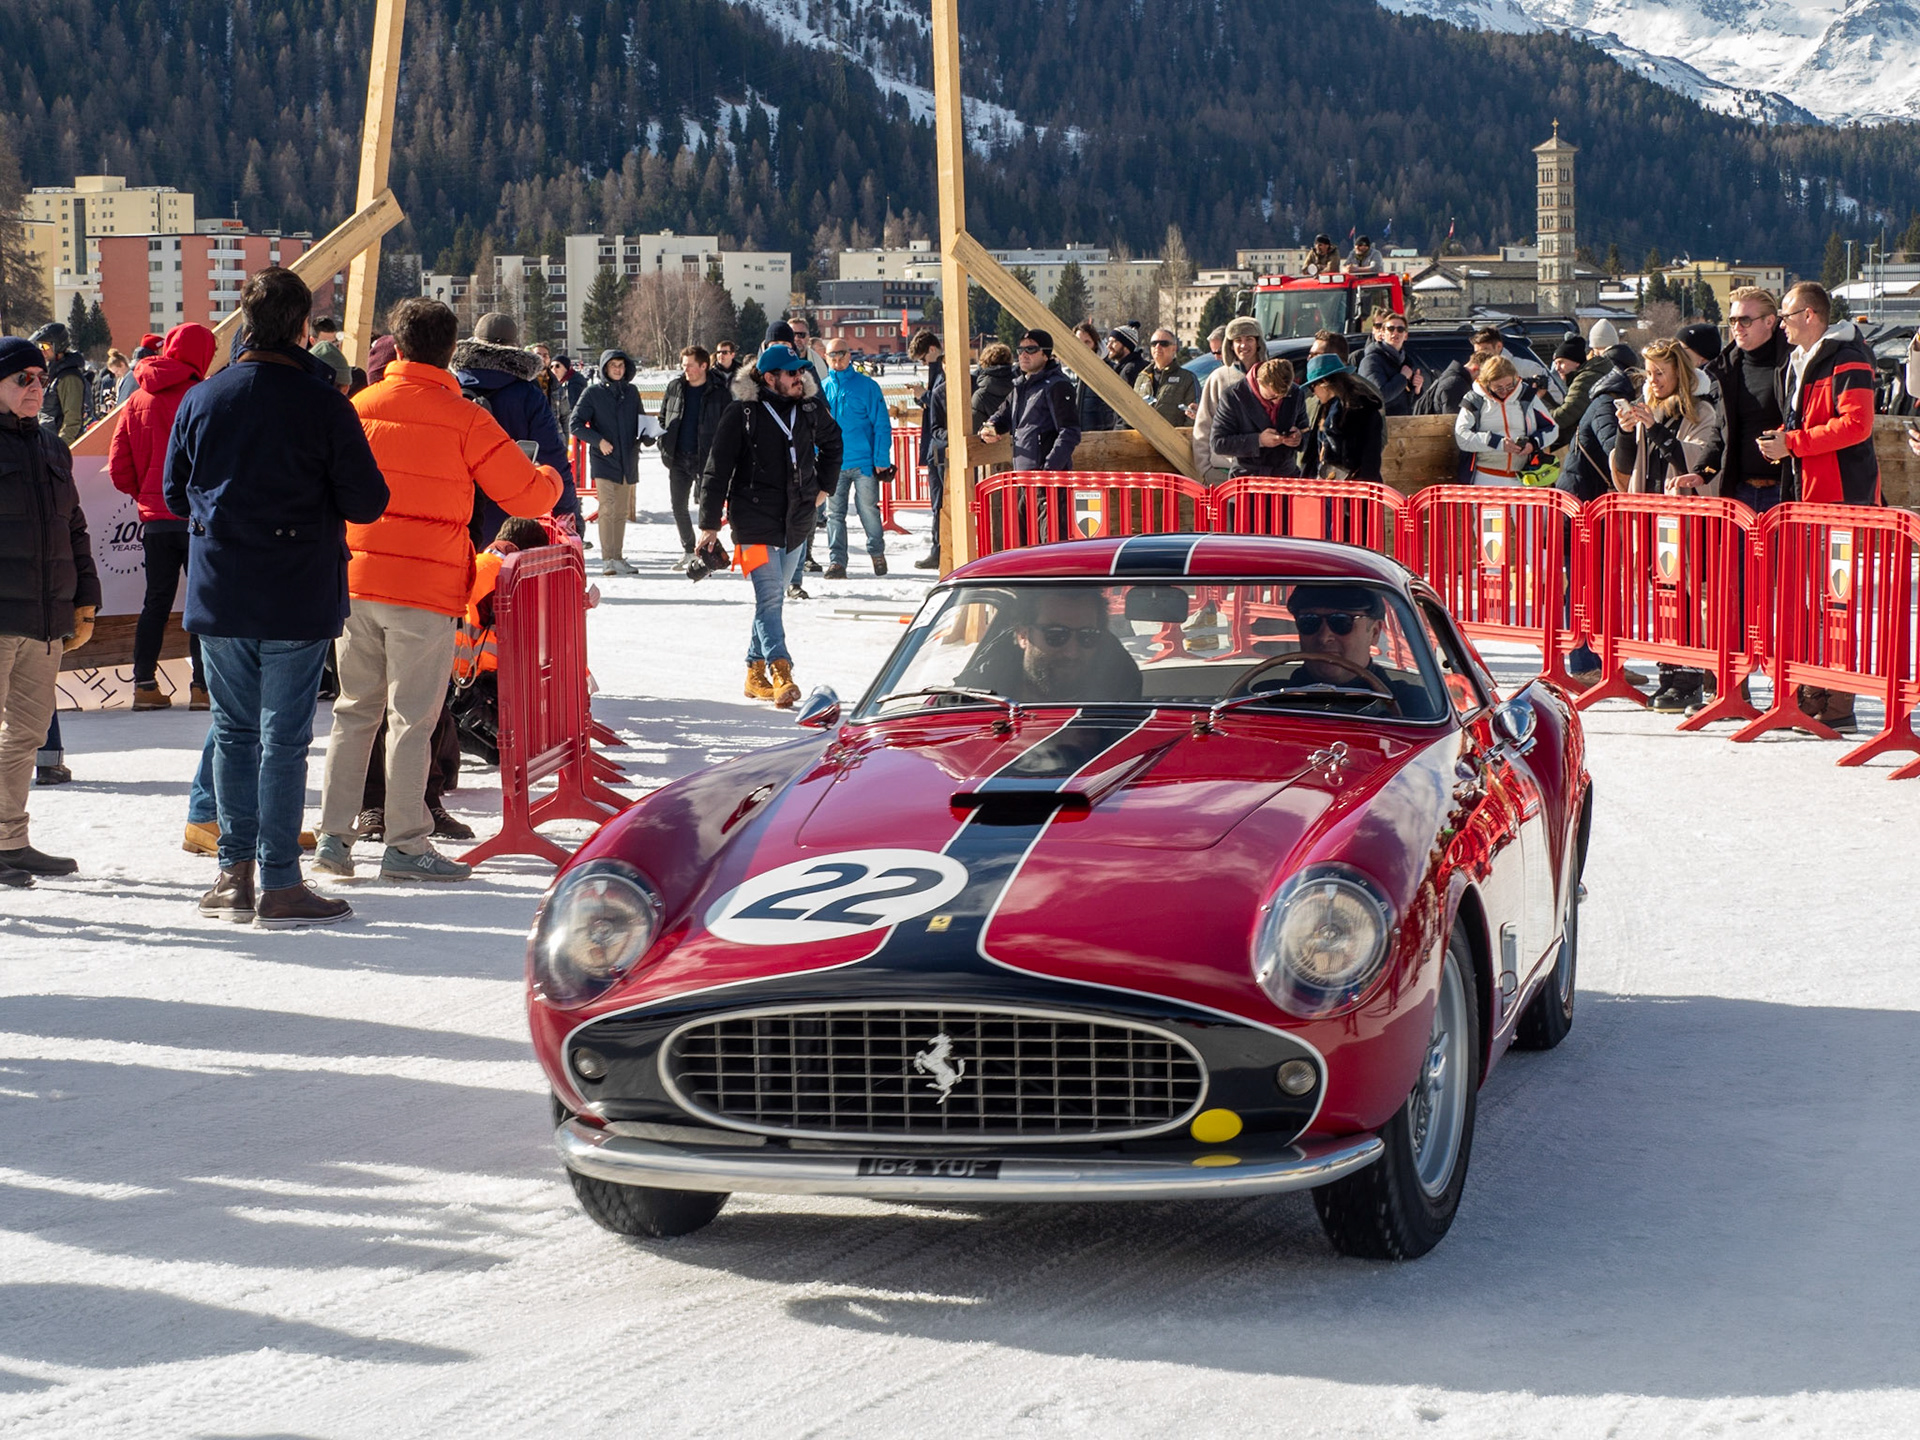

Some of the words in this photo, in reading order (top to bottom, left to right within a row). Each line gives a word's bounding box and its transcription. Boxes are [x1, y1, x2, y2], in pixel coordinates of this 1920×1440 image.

[417, 855, 435, 869] N
[730, 862, 944, 926] 22
[867, 1159, 917, 1175] 164
